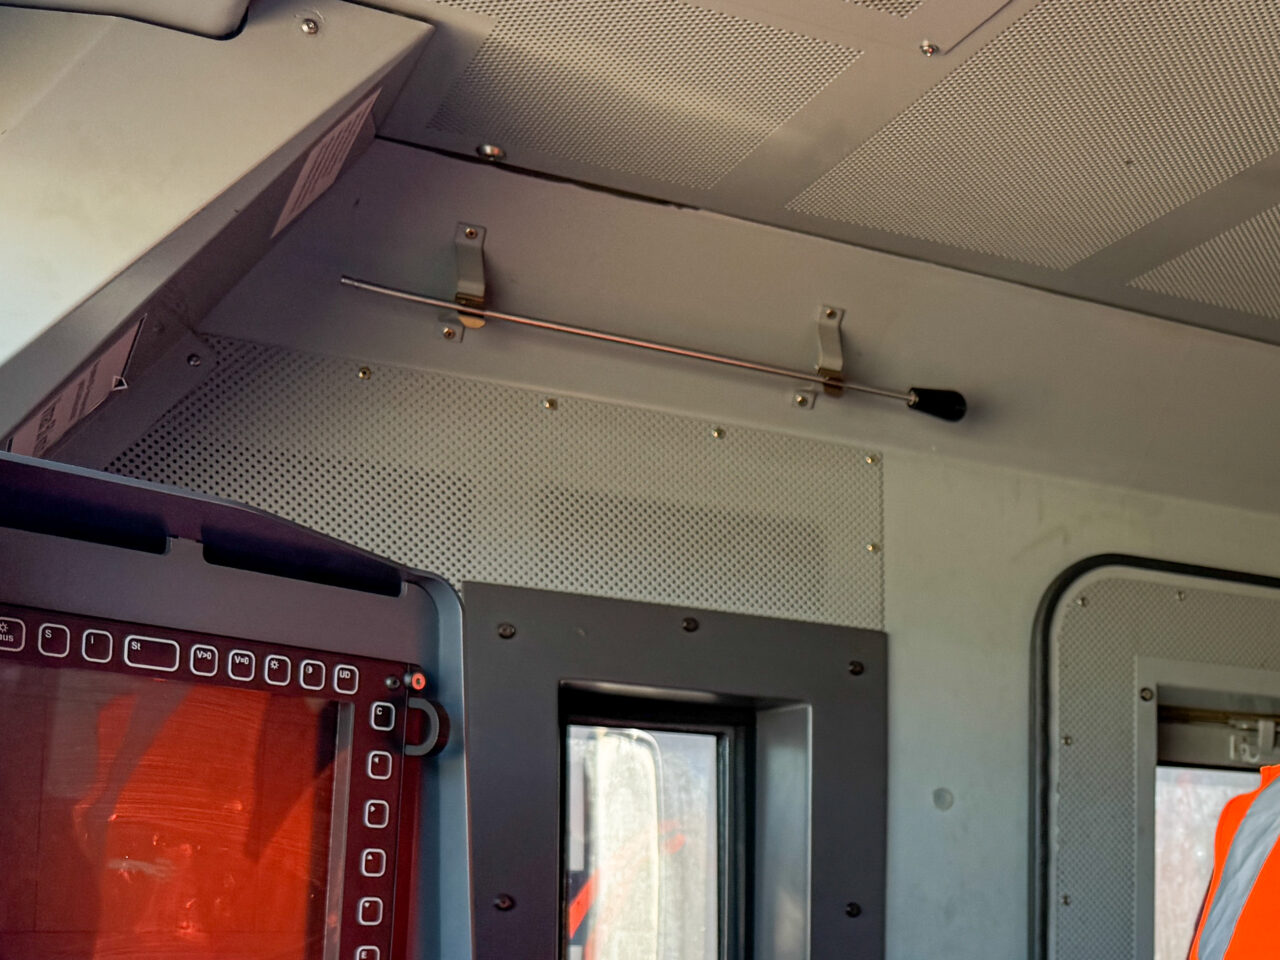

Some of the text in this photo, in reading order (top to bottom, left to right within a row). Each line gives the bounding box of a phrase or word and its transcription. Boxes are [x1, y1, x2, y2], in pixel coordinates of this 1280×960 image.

[45, 629, 52, 639] S
[131, 641, 141, 651] St
[196, 650, 212, 660] V>0
[234, 655, 249, 665] V=0
[339, 670, 351, 679] UD
[376, 707, 383, 715] C
